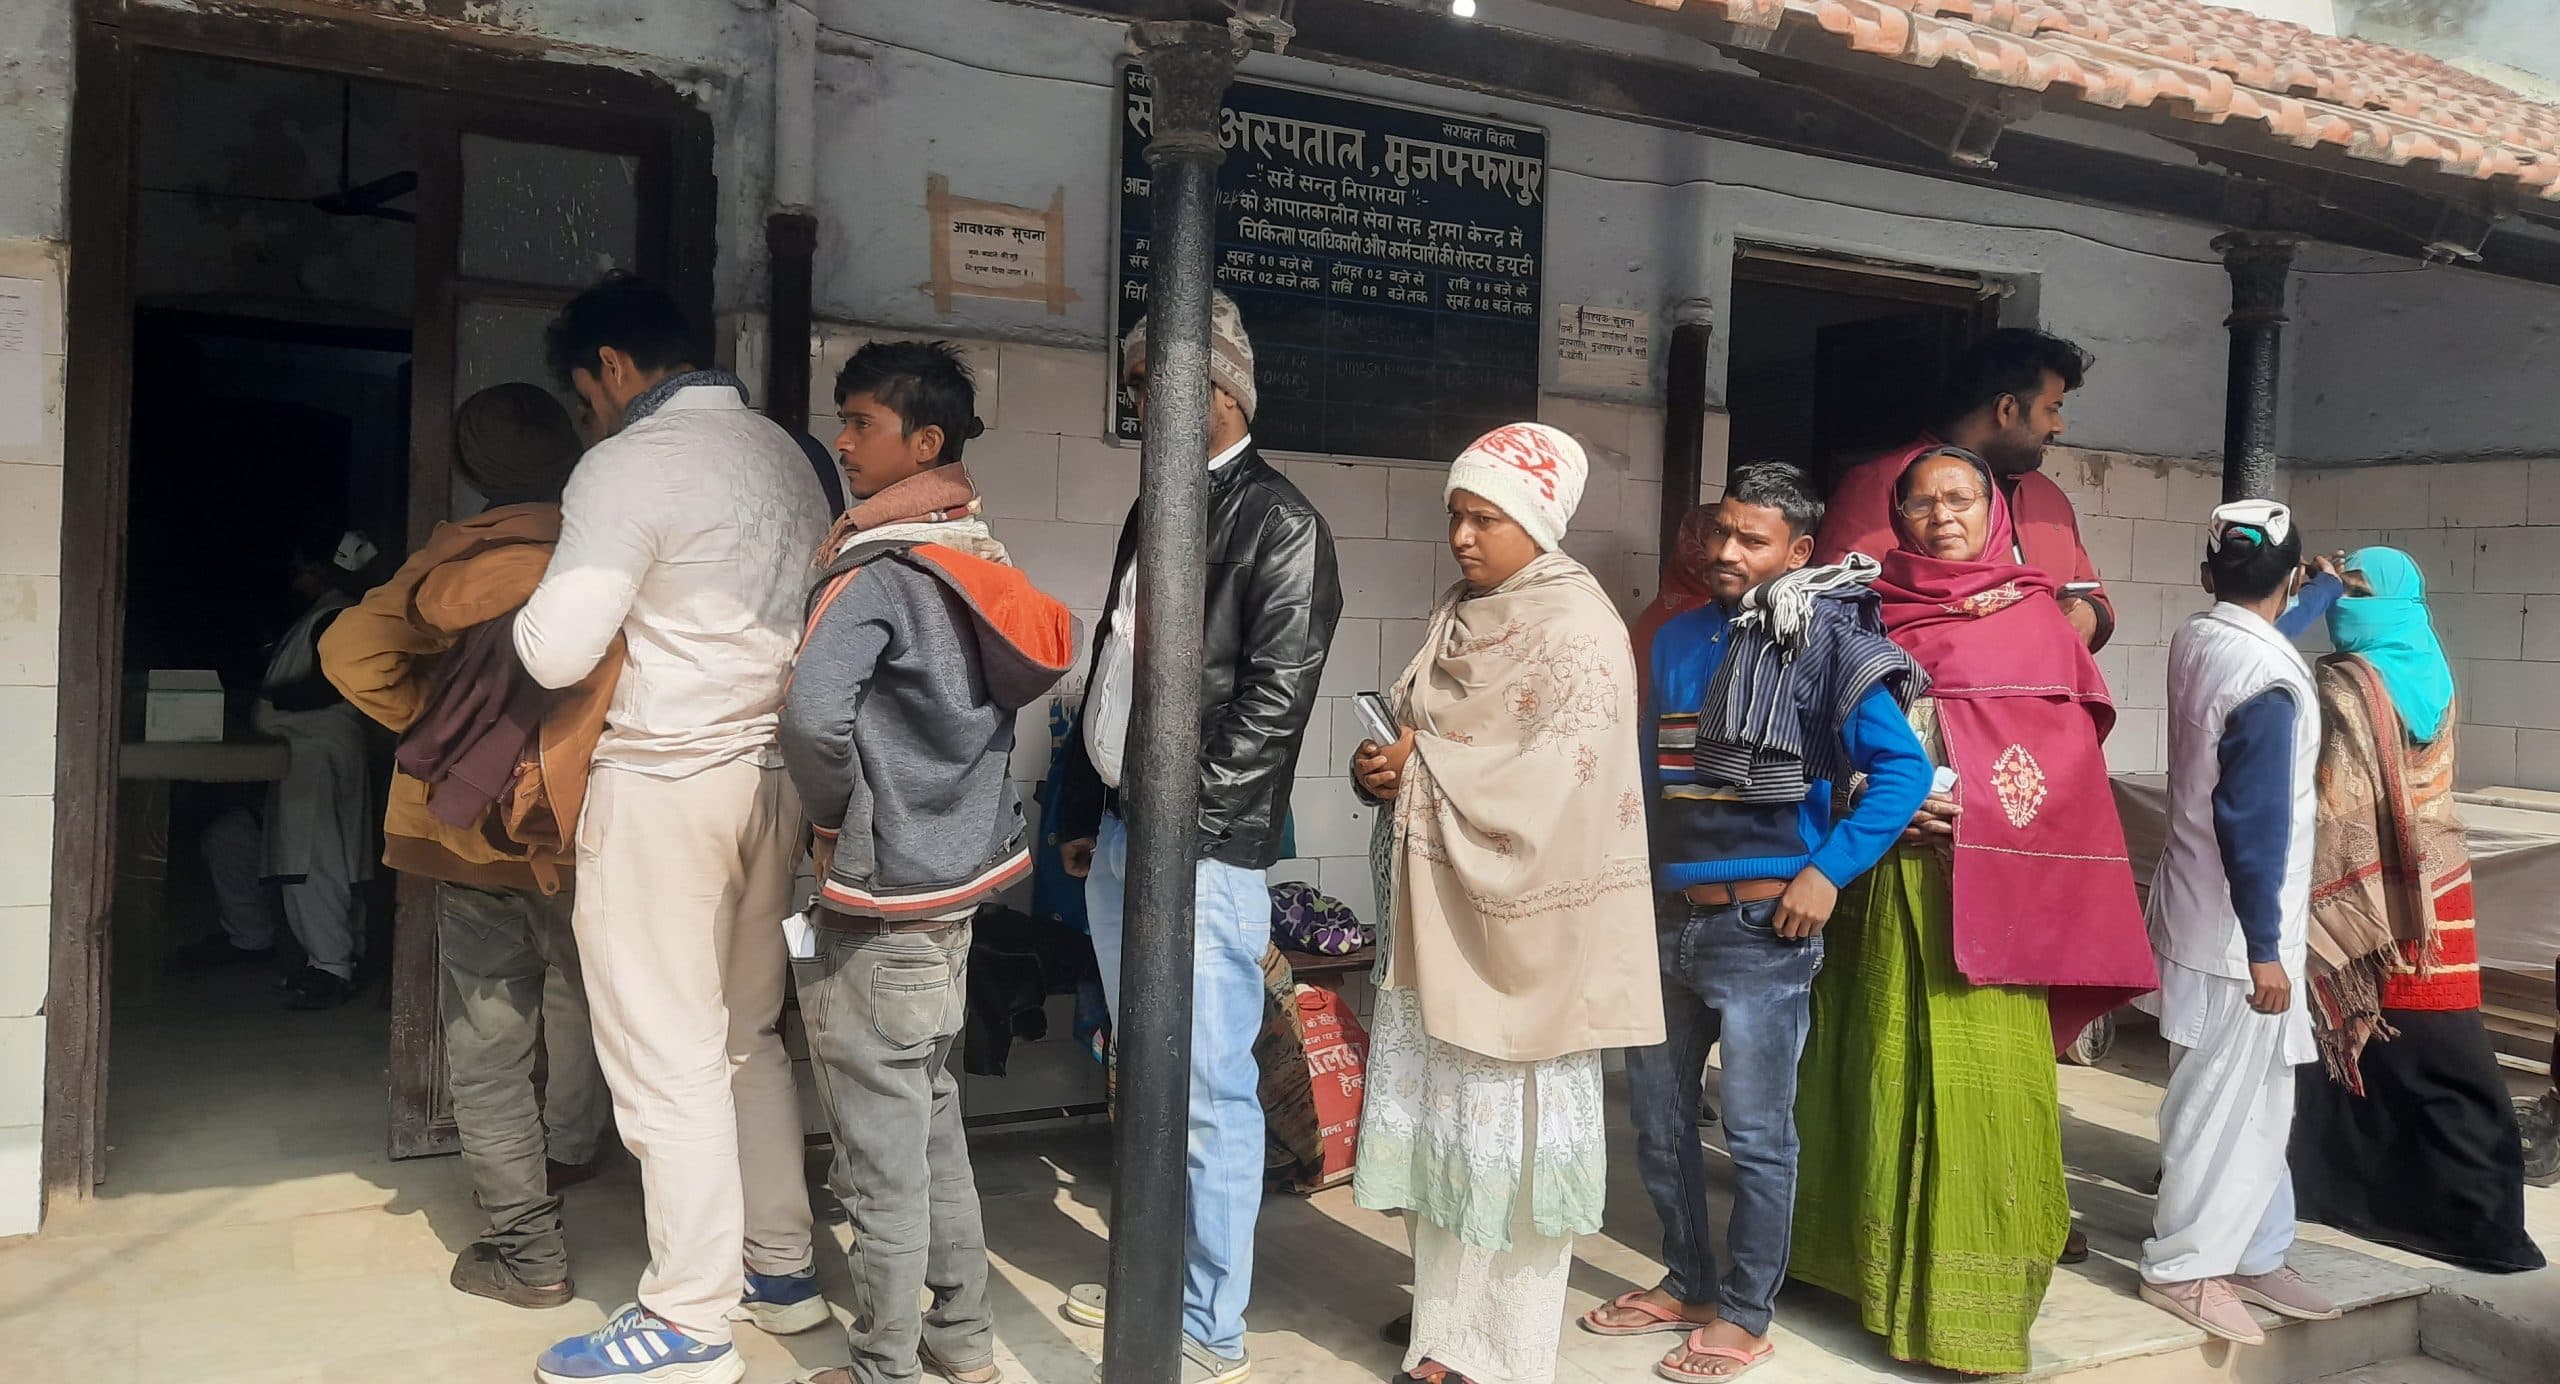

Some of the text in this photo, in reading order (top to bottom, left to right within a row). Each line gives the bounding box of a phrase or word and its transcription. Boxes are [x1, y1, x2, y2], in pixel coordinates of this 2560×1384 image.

[1442, 122, 1483, 144] सशक्त
[1384, 134, 1542, 206] मुजफ्फरपुर
[1299, 174, 1337, 202] सन्तु
[1239, 189, 1523, 249] को आपातकालीन सेवा सह ट्रामा केन्द्र में
[953, 221, 1046, 245] आवश्यक सूचना
[1238, 216, 1296, 247] चिकित्सा
[1298, 227, 1362, 254] पदाधिकारी
[1362, 233, 1387, 259] और
[1388, 239, 1439, 264] कर्मचारी
[1455, 245, 1492, 272] रोस्टर
[1217, 263, 1321, 290] दोपहर 02 बजे तक
[1301, 256, 1313, 273] से
[1331, 261, 1425, 287] दोपहर 02 बजे से
[1362, 285, 1377, 297] 08
[1387, 285, 1406, 301] बजे
[1406, 290, 1429, 304] तक
[1493, 281, 1512, 296] बजे
[1474, 298, 1489, 310] 08
[1492, 297, 1513, 313] बजे
[1513, 302, 1533, 316] तक
